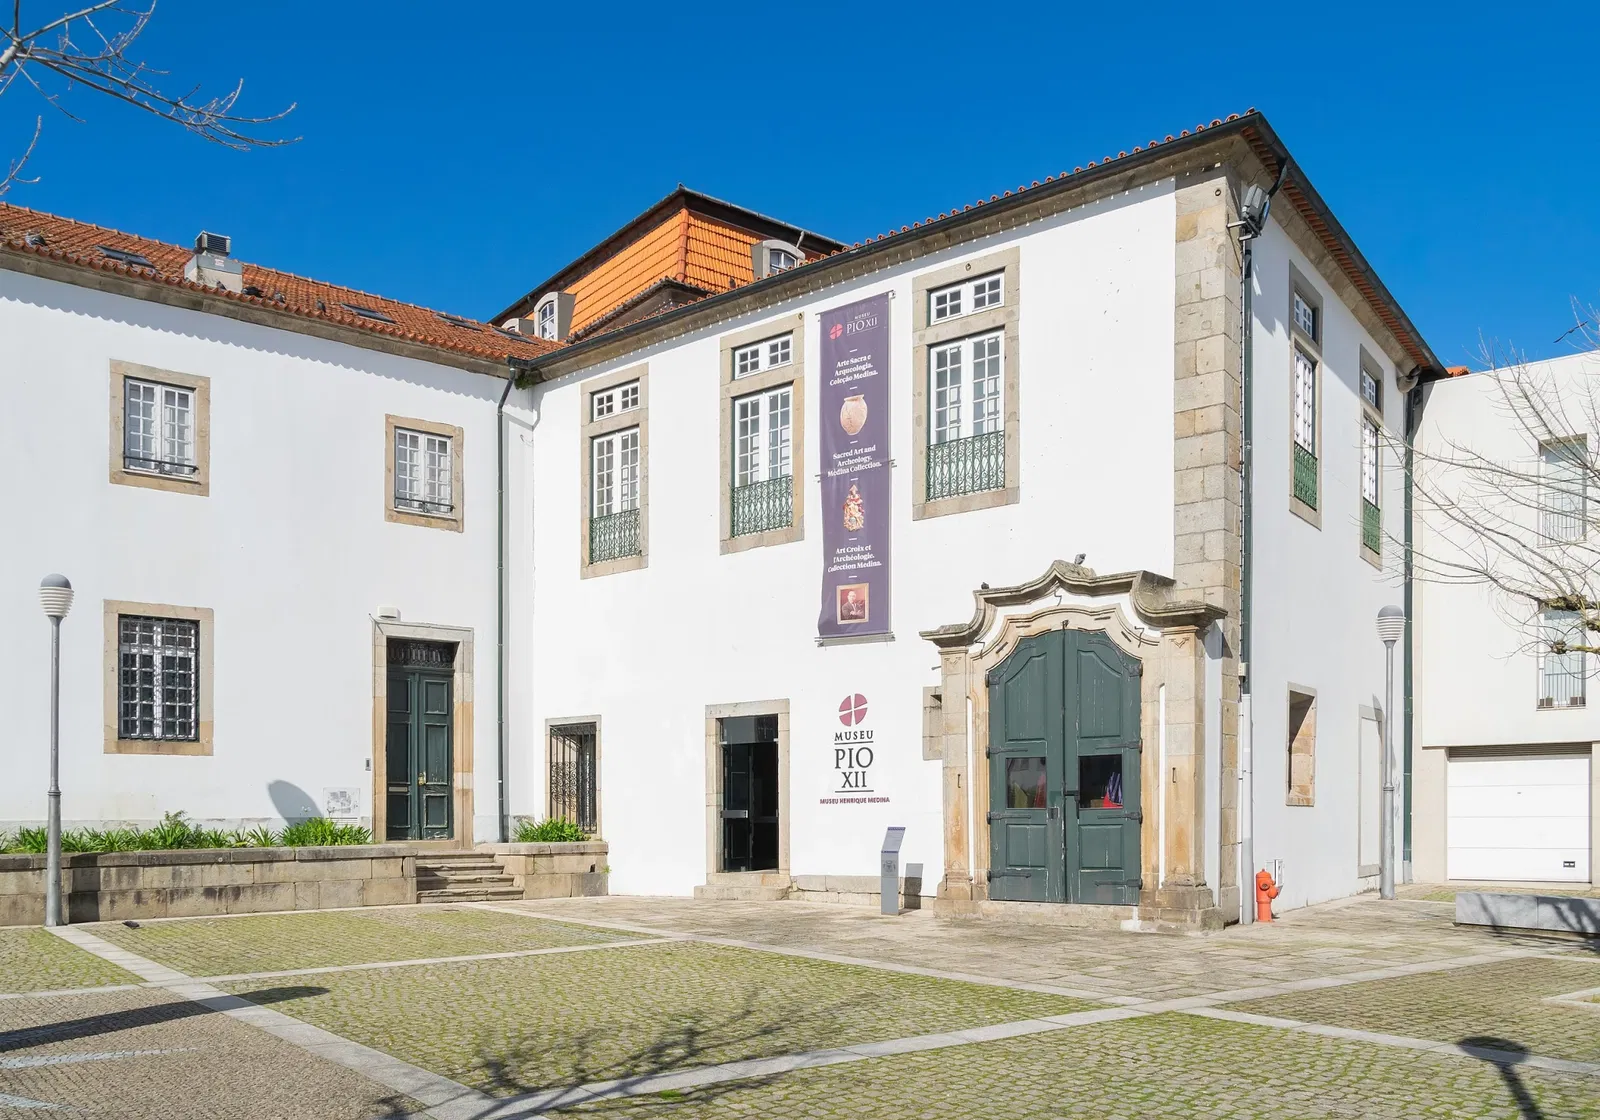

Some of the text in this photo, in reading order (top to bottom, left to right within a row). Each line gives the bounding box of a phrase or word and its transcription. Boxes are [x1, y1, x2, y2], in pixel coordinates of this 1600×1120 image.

[846, 317, 878, 334] PIO XII
[836, 360, 850, 368] Arte
[850, 355, 867, 364] Sacra
[834, 362, 873, 377] Arqueologia.
[829, 370, 879, 386] Coleção Medina.
[832, 444, 876, 460] Sacred Art and
[837, 455, 873, 467] Archeology.
[849, 461, 882, 473] Collection.
[836, 547, 846, 555] Art
[846, 545, 864, 553] Croix
[827, 560, 882, 573] Collection Medina.
[834, 730, 874, 742] MUSEU
[834, 746, 874, 769] PIO
[841, 771, 867, 788] XII
[839, 797, 867, 805] HENRIQUE
[867, 796, 890, 804] MEDINA
